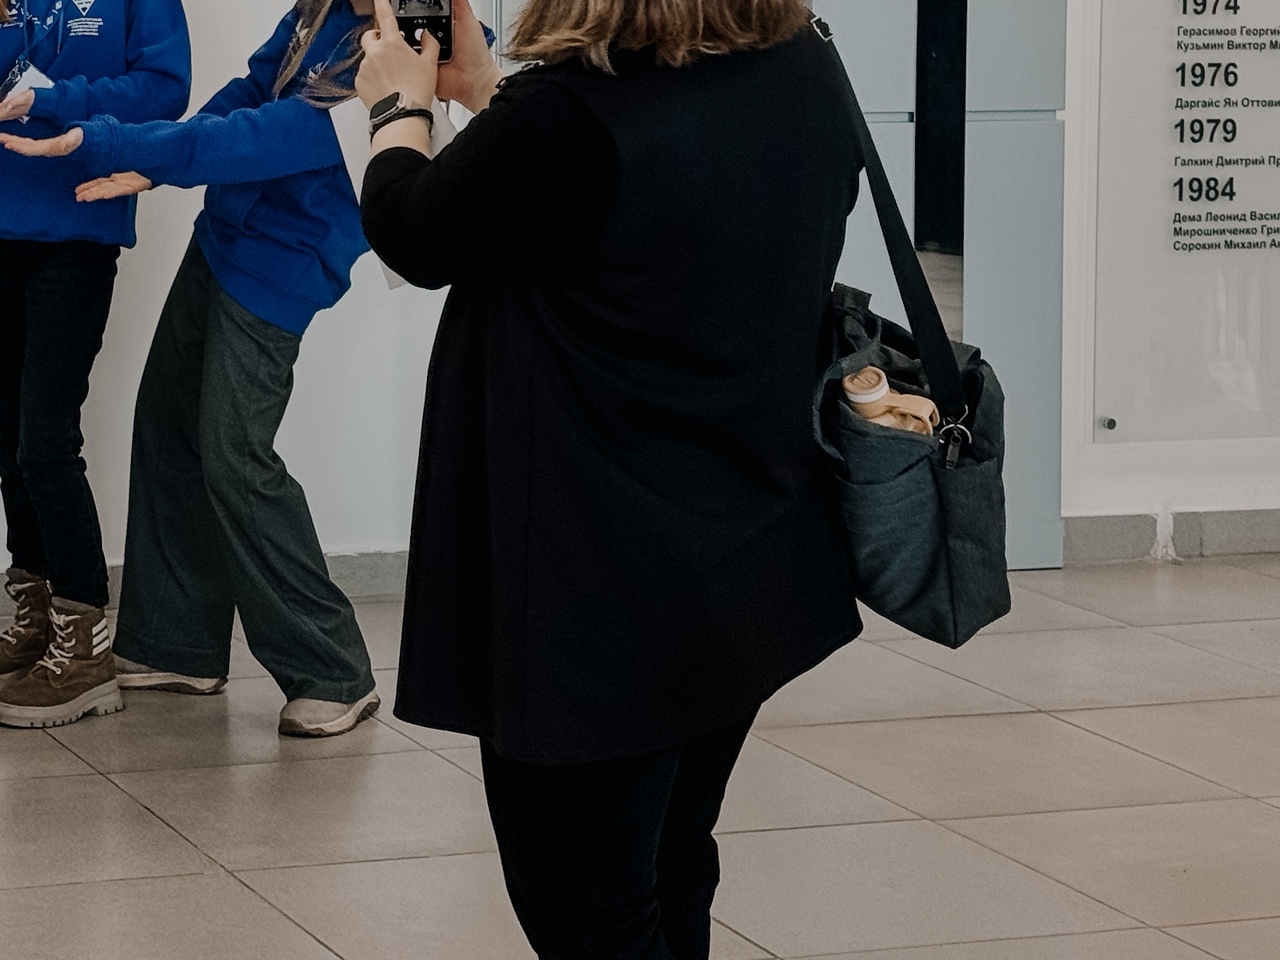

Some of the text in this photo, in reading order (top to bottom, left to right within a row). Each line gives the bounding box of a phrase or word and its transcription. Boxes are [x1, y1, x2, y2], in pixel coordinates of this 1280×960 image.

[1177, 26, 1237, 38] Герасимов
[1177, 40, 1280, 53] Кузьмин Виктор М
[1176, 62, 1238, 87] 1976
[1175, 97, 1220, 110] Даргайс
[1223, 97, 1238, 108] Ян
[1174, 118, 1237, 143] 1979
[1174, 156, 1213, 167] Галкин
[1215, 155, 1265, 168] Дмитрий
[1173, 177, 1236, 202] 1984
[1173, 212, 1202, 224] Дема
[1205, 212, 1247, 222] Леонид
[1173, 226, 1258, 238] Мирошниченко
[1173, 240, 1221, 253] Сорокин
[1224, 239, 1266, 250] Михаил
